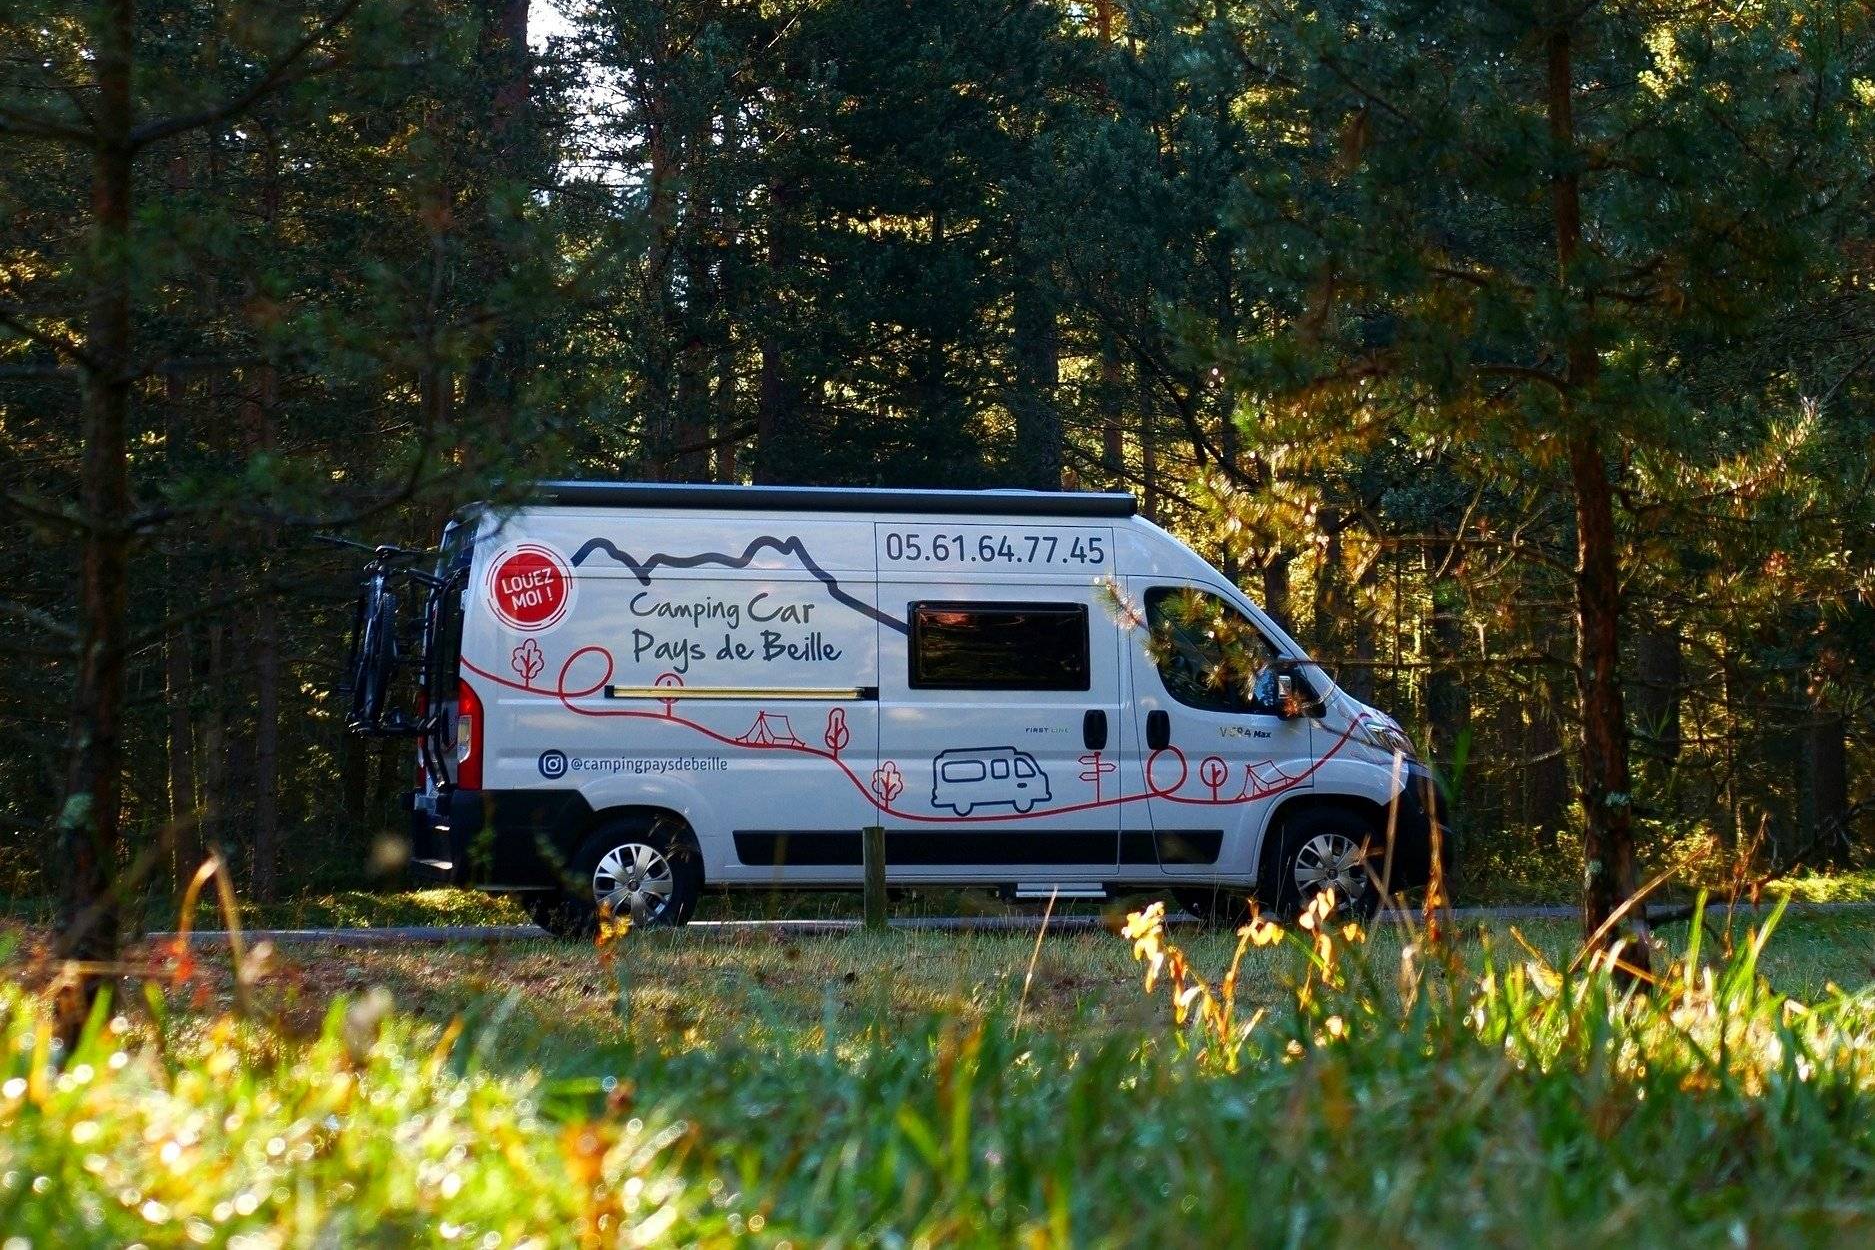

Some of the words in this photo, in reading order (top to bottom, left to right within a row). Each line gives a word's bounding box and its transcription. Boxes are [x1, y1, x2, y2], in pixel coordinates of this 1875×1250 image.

[886, 532, 1105, 564] 05.61.64.77.45
[501, 567, 555, 595] LOUEZ
[511, 588, 543, 611] MOI
[629, 591, 740, 630] Camping
[747, 592, 815, 624] Car
[632, 628, 706, 674] Pays
[716, 633, 754, 661] de
[760, 629, 842, 662] Beille
[571, 756, 728, 774] @campingpaysdebeille
